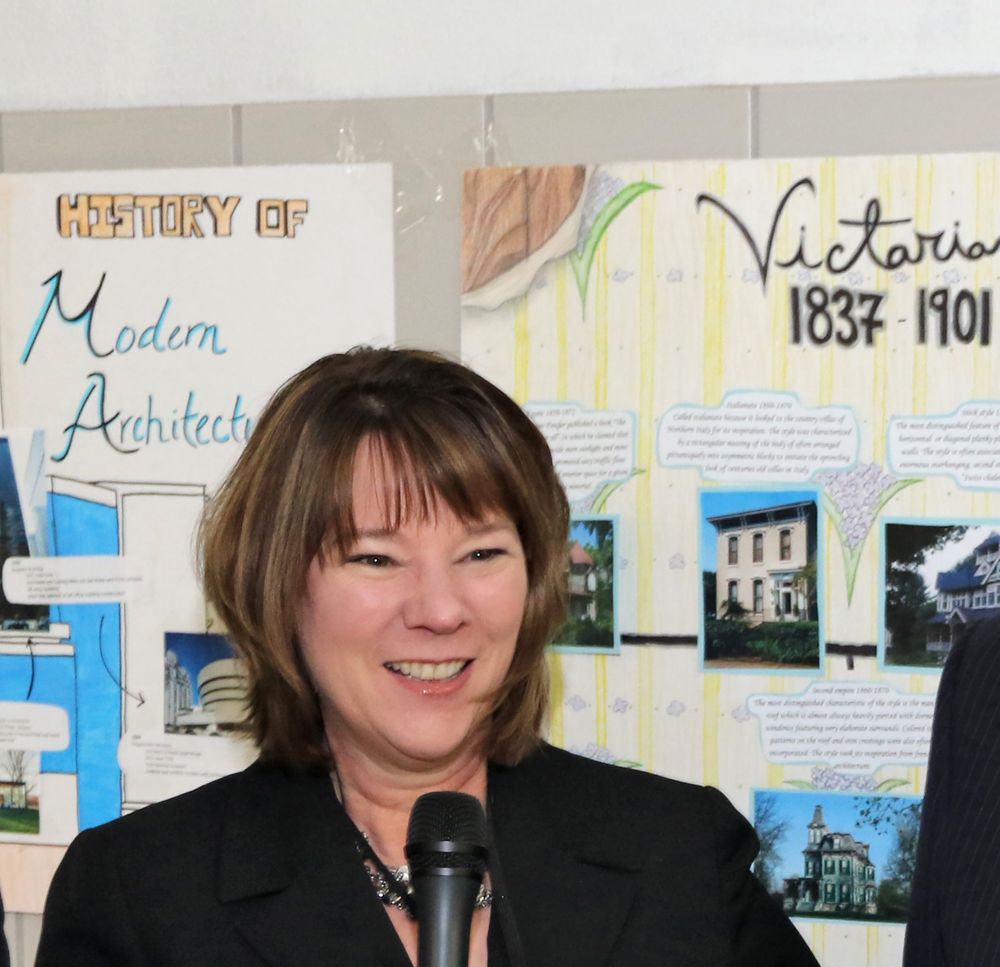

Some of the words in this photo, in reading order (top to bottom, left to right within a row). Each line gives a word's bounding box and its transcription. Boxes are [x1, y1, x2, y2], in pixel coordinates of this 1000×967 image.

[56, 193, 241, 238] HISTORY
[256, 199, 309, 239] OF
[19, 270, 228, 365] Modern
[789, 286, 885, 346] 1837
[917, 287, 993, 346] 1901
